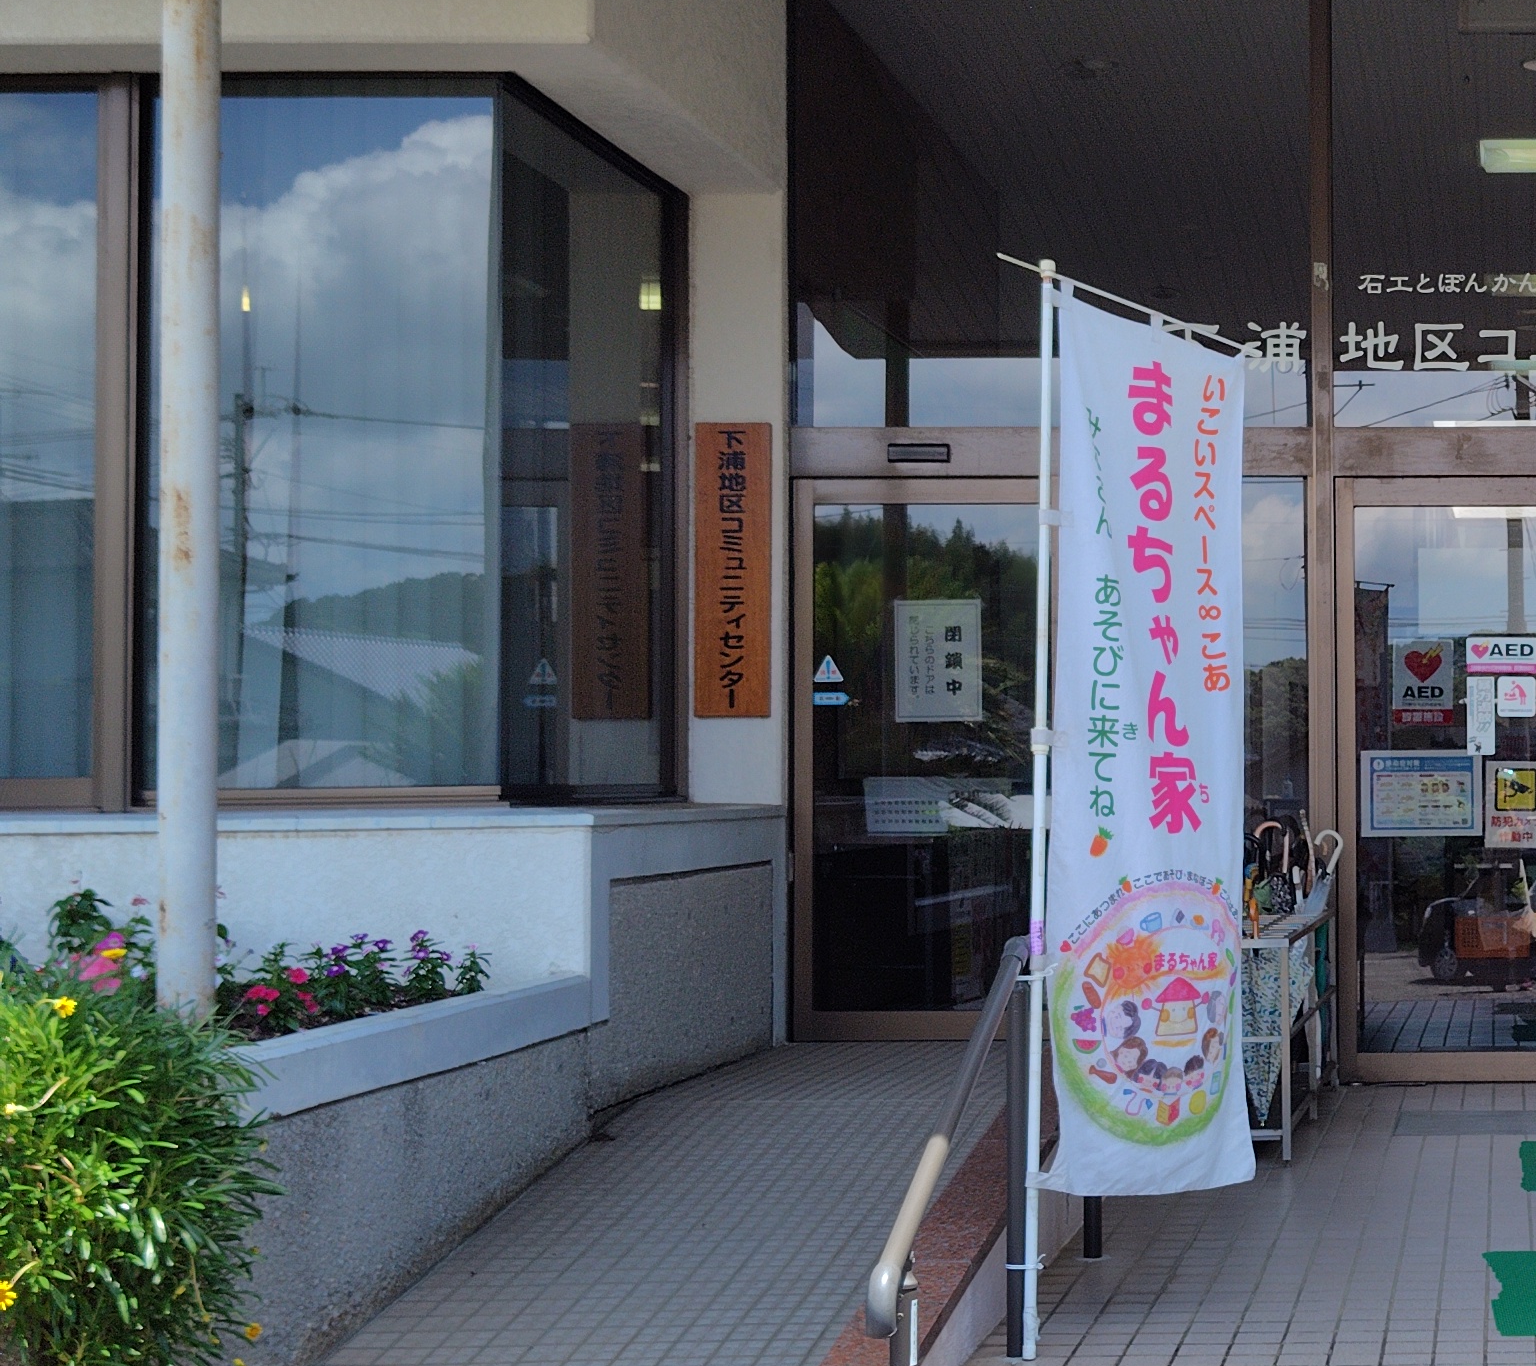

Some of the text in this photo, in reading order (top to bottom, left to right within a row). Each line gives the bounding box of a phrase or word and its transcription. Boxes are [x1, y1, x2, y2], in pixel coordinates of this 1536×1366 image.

[718, 430, 747, 708] 下浦地区コミュニティセンター
[1128, 361, 1202, 834] まるちゃん家
[1489, 643, 1534, 657] AED
[1088, 575, 1122, 817] あそびに来てね
[1402, 686, 1444, 699] AED
[1122, 721, 1138, 741] き
[1154, 952, 1218, 972] まるちゃん家
